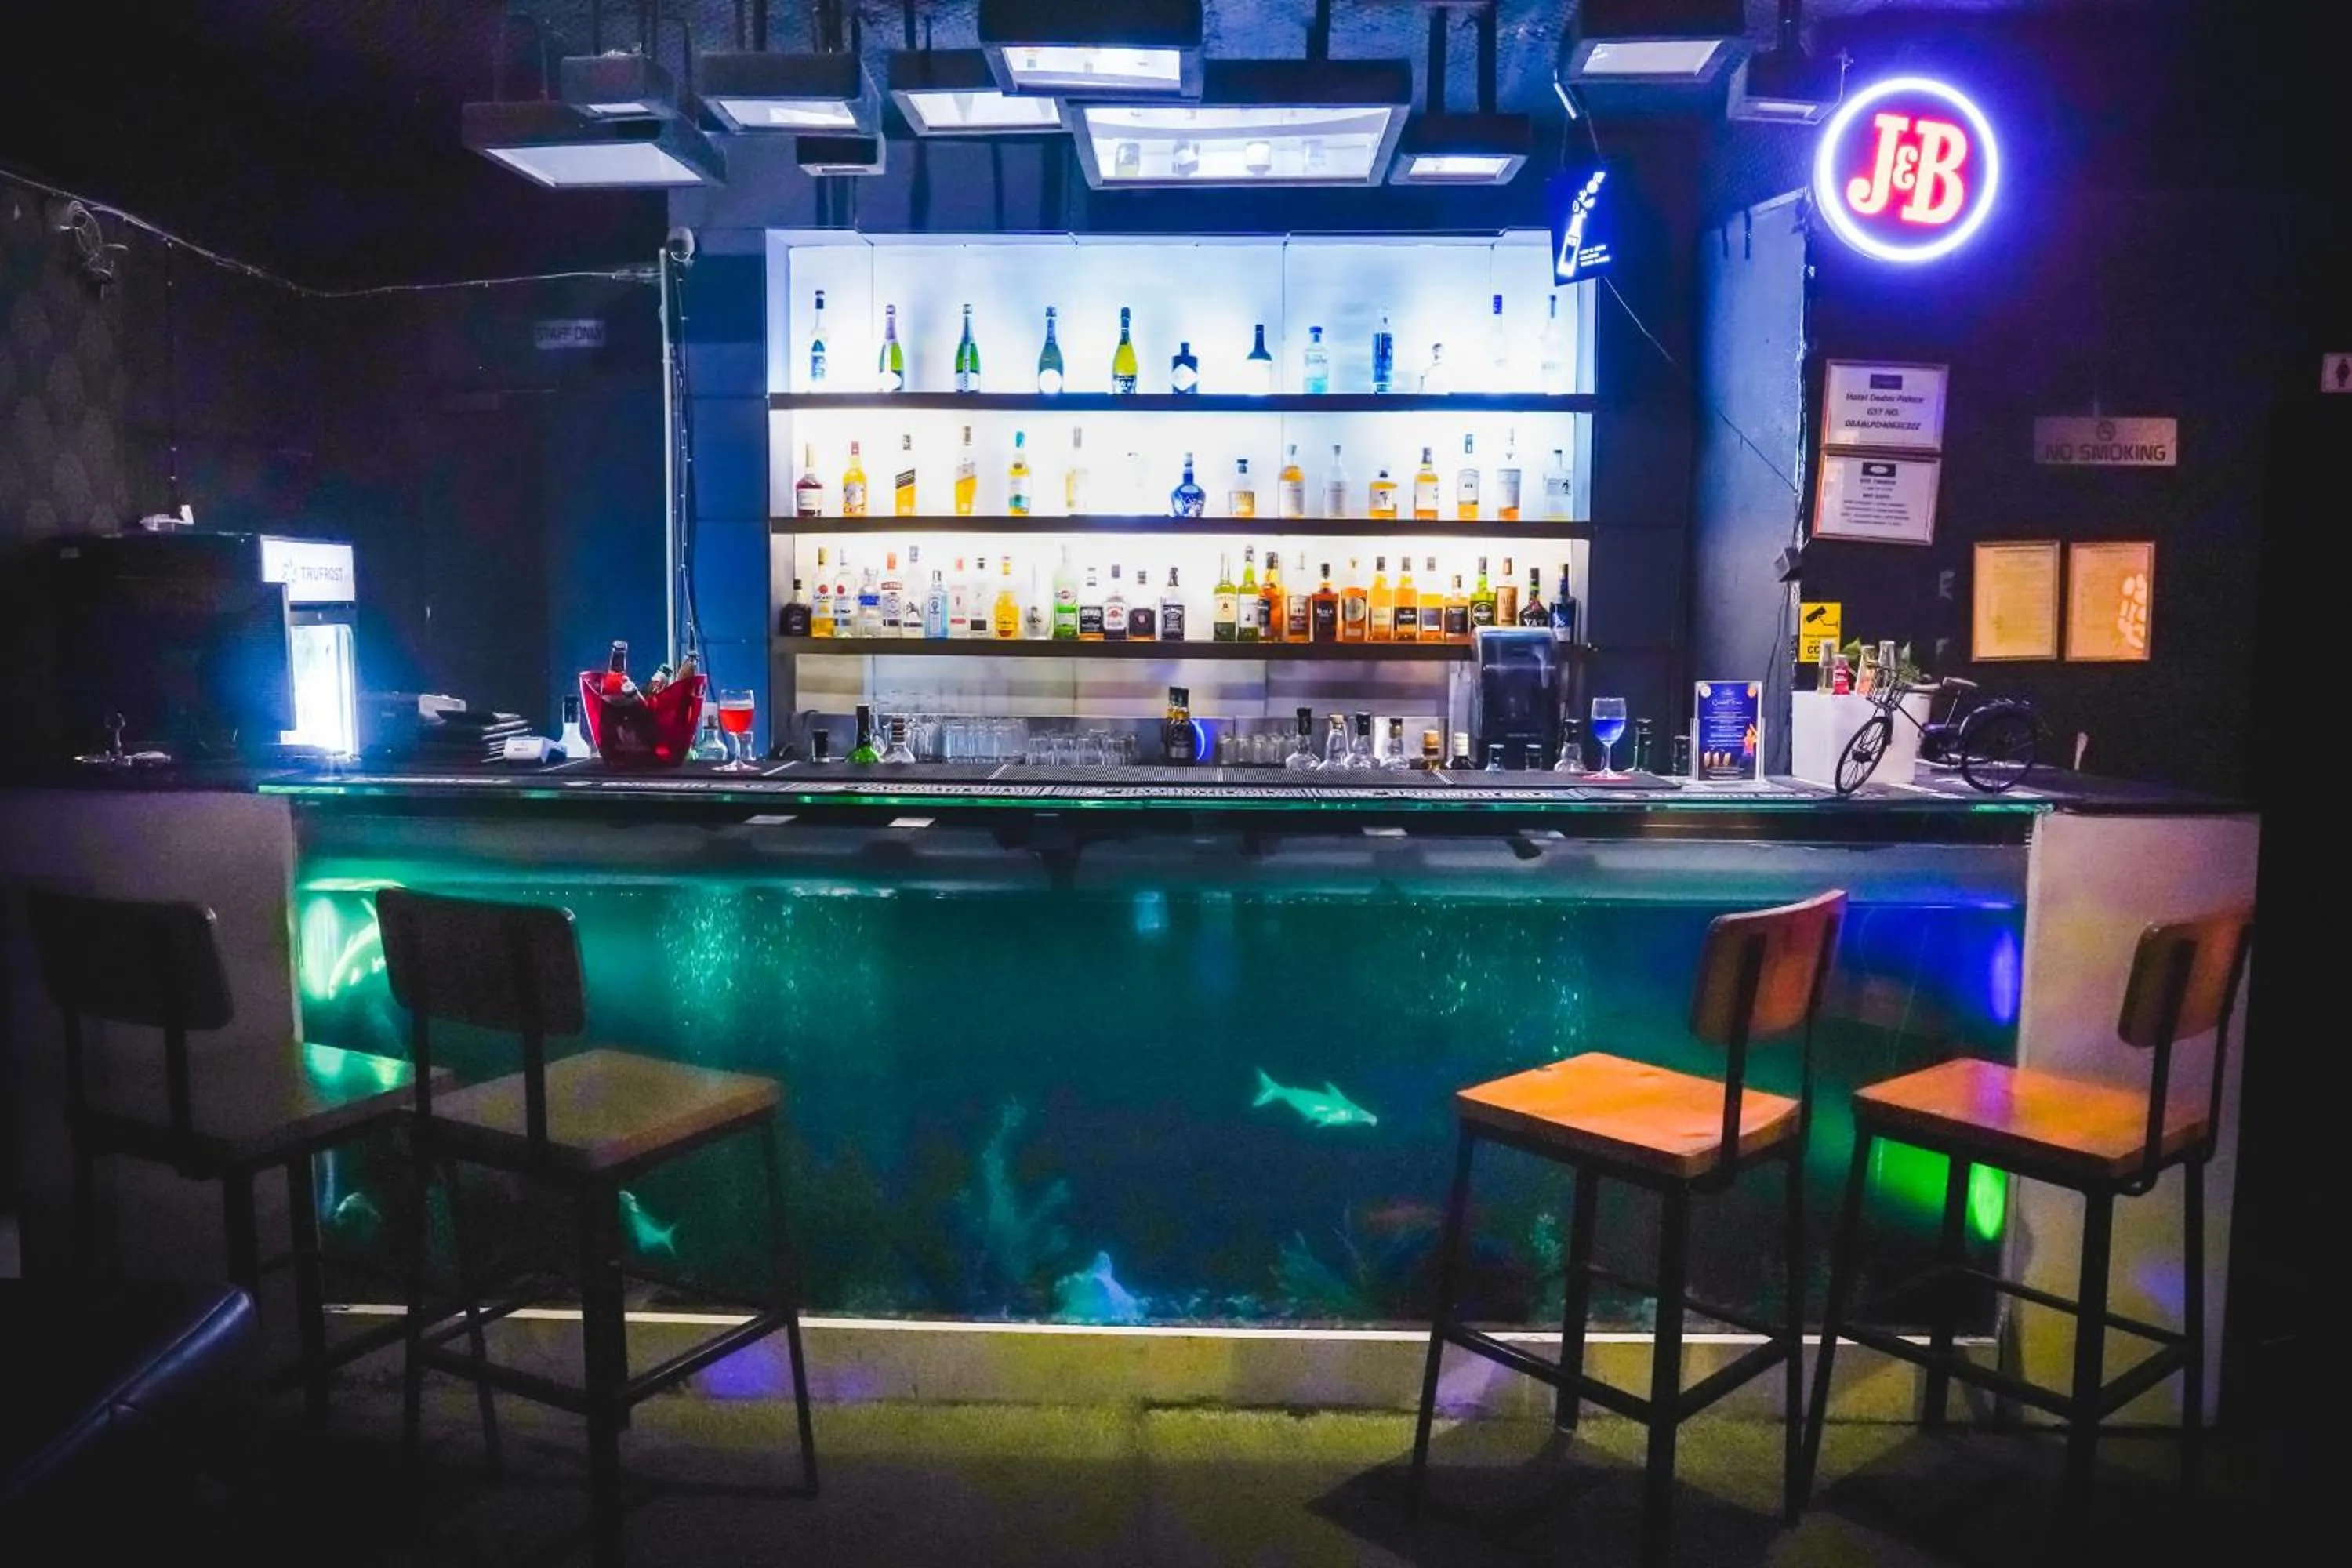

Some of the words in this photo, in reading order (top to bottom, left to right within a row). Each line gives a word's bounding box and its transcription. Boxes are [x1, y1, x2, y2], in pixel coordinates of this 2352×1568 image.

[1846, 113, 1967, 224] J&B
[2045, 442, 2072, 461] NO
[2080, 444, 2167, 462] SMOKING
[300, 566, 343, 583] TRUFROST
